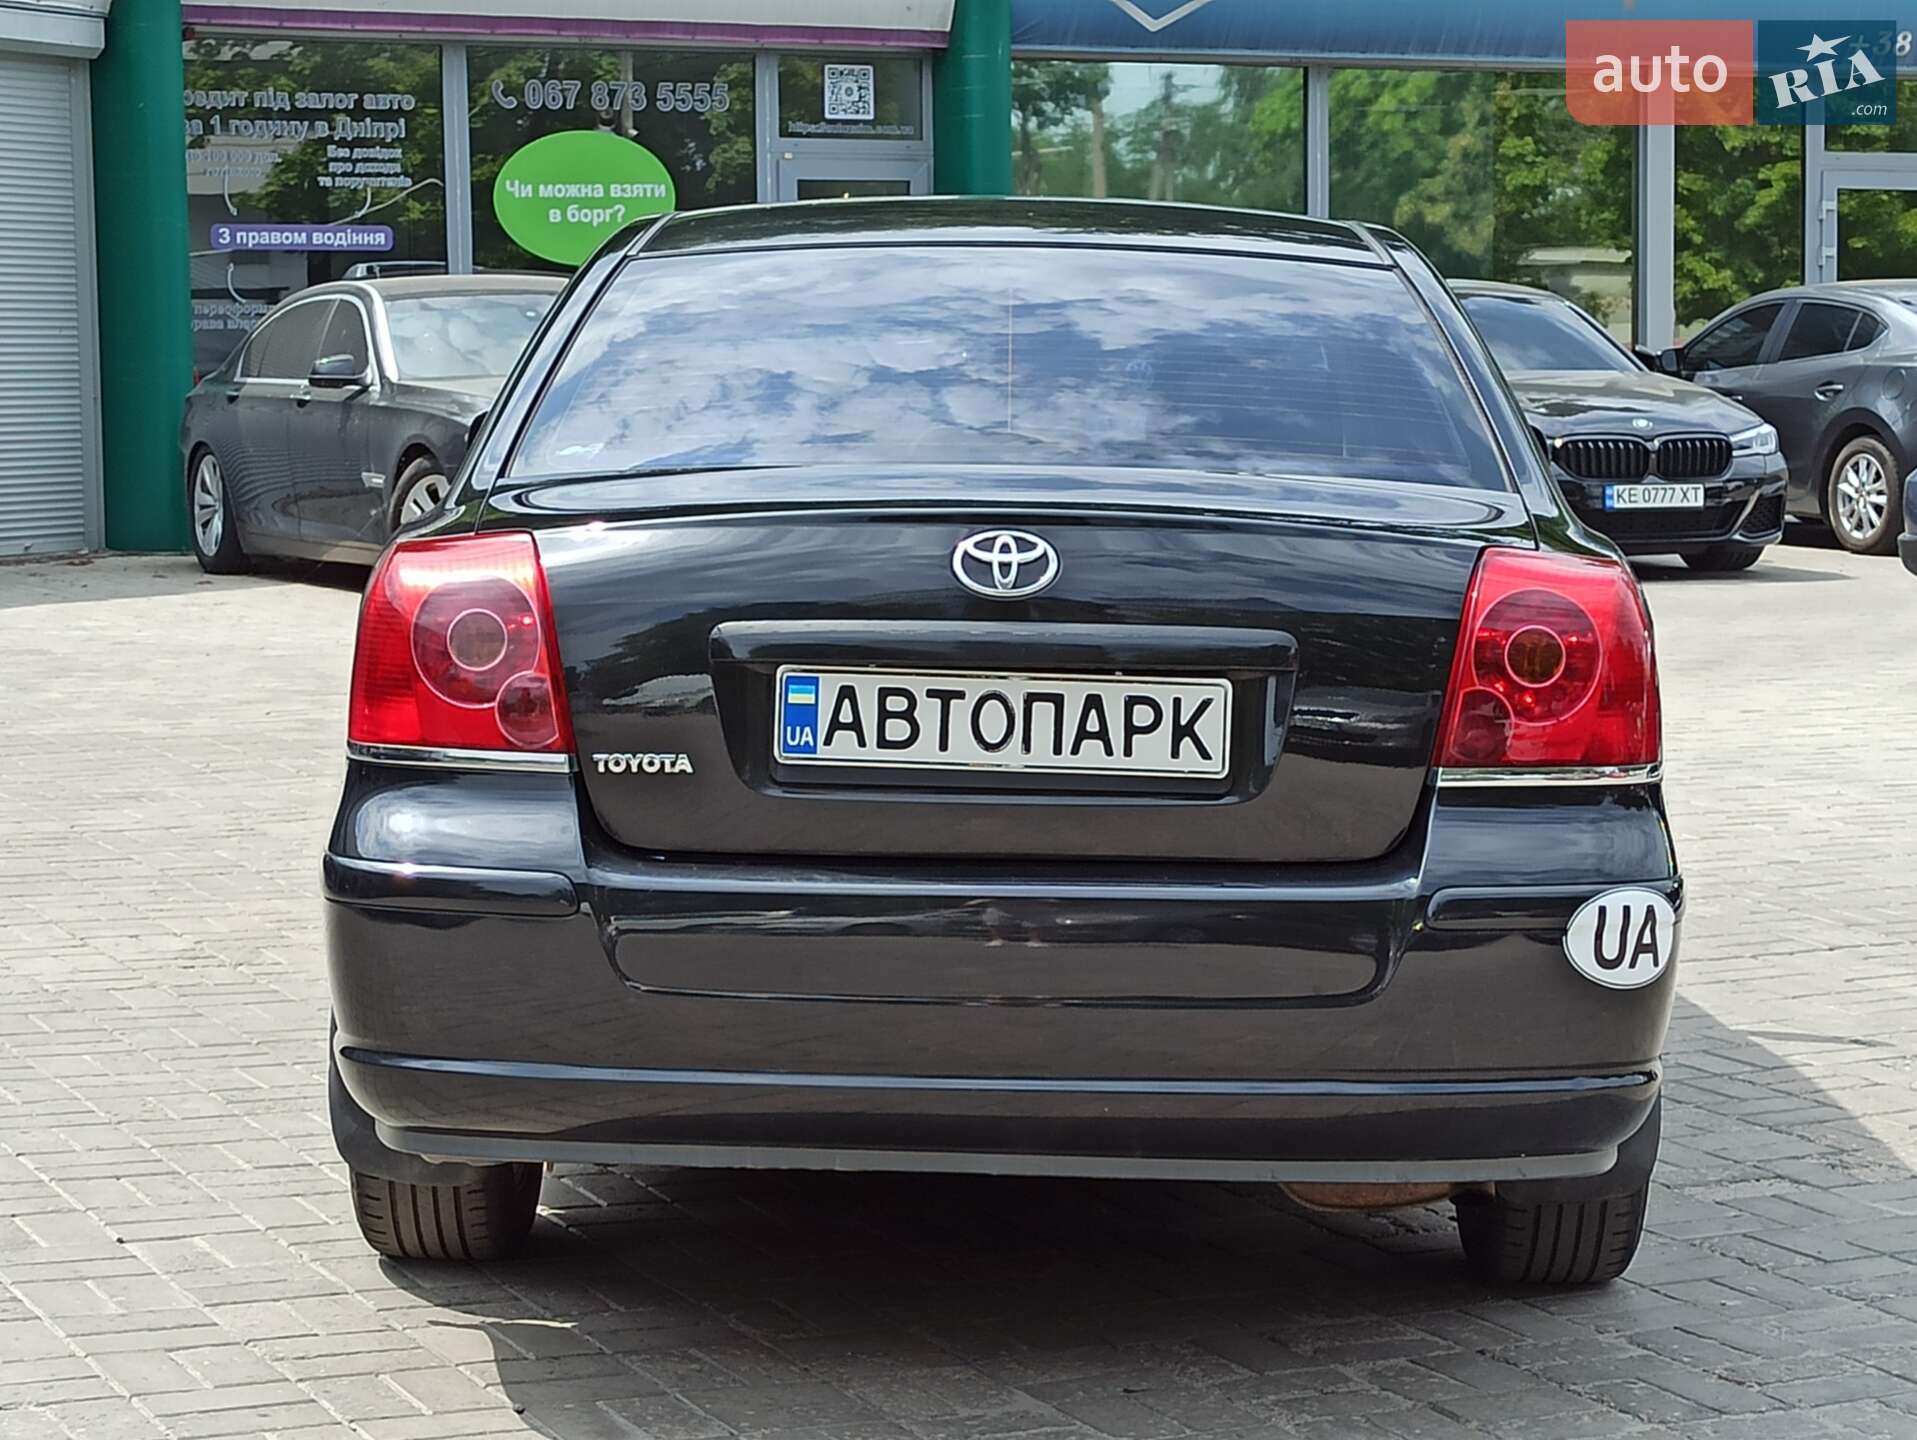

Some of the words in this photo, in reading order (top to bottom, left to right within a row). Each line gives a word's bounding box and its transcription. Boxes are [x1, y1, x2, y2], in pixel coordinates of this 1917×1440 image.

[254, 86, 291, 111] під
[294, 92, 359, 109] залог
[363, 93, 416, 111] авто
[524, 79, 582, 110] 067
[591, 80, 647, 111] 873
[656, 82, 730, 112] 5555
[209, 114, 221, 135] 1
[228, 119, 309, 142] годину
[314, 121, 330, 138] в
[334, 116, 406, 142] Дніпрі
[505, 179, 533, 198] Чи
[539, 183, 604, 198] можна
[610, 183, 666, 198] взяти
[549, 208, 562, 223] в
[567, 204, 625, 228] борг?
[236, 231, 307, 247] правом
[311, 231, 386, 247] водіння
[1616, 487, 1639, 504] KE
[1642, 487, 1676, 504] 0777
[1680, 487, 1701, 504] XT
[822, 684, 1215, 761] АВТОПАРК
[786, 726, 814, 747] UA
[592, 753, 694, 774] TOYOTA
[1594, 904, 1659, 970] UA
